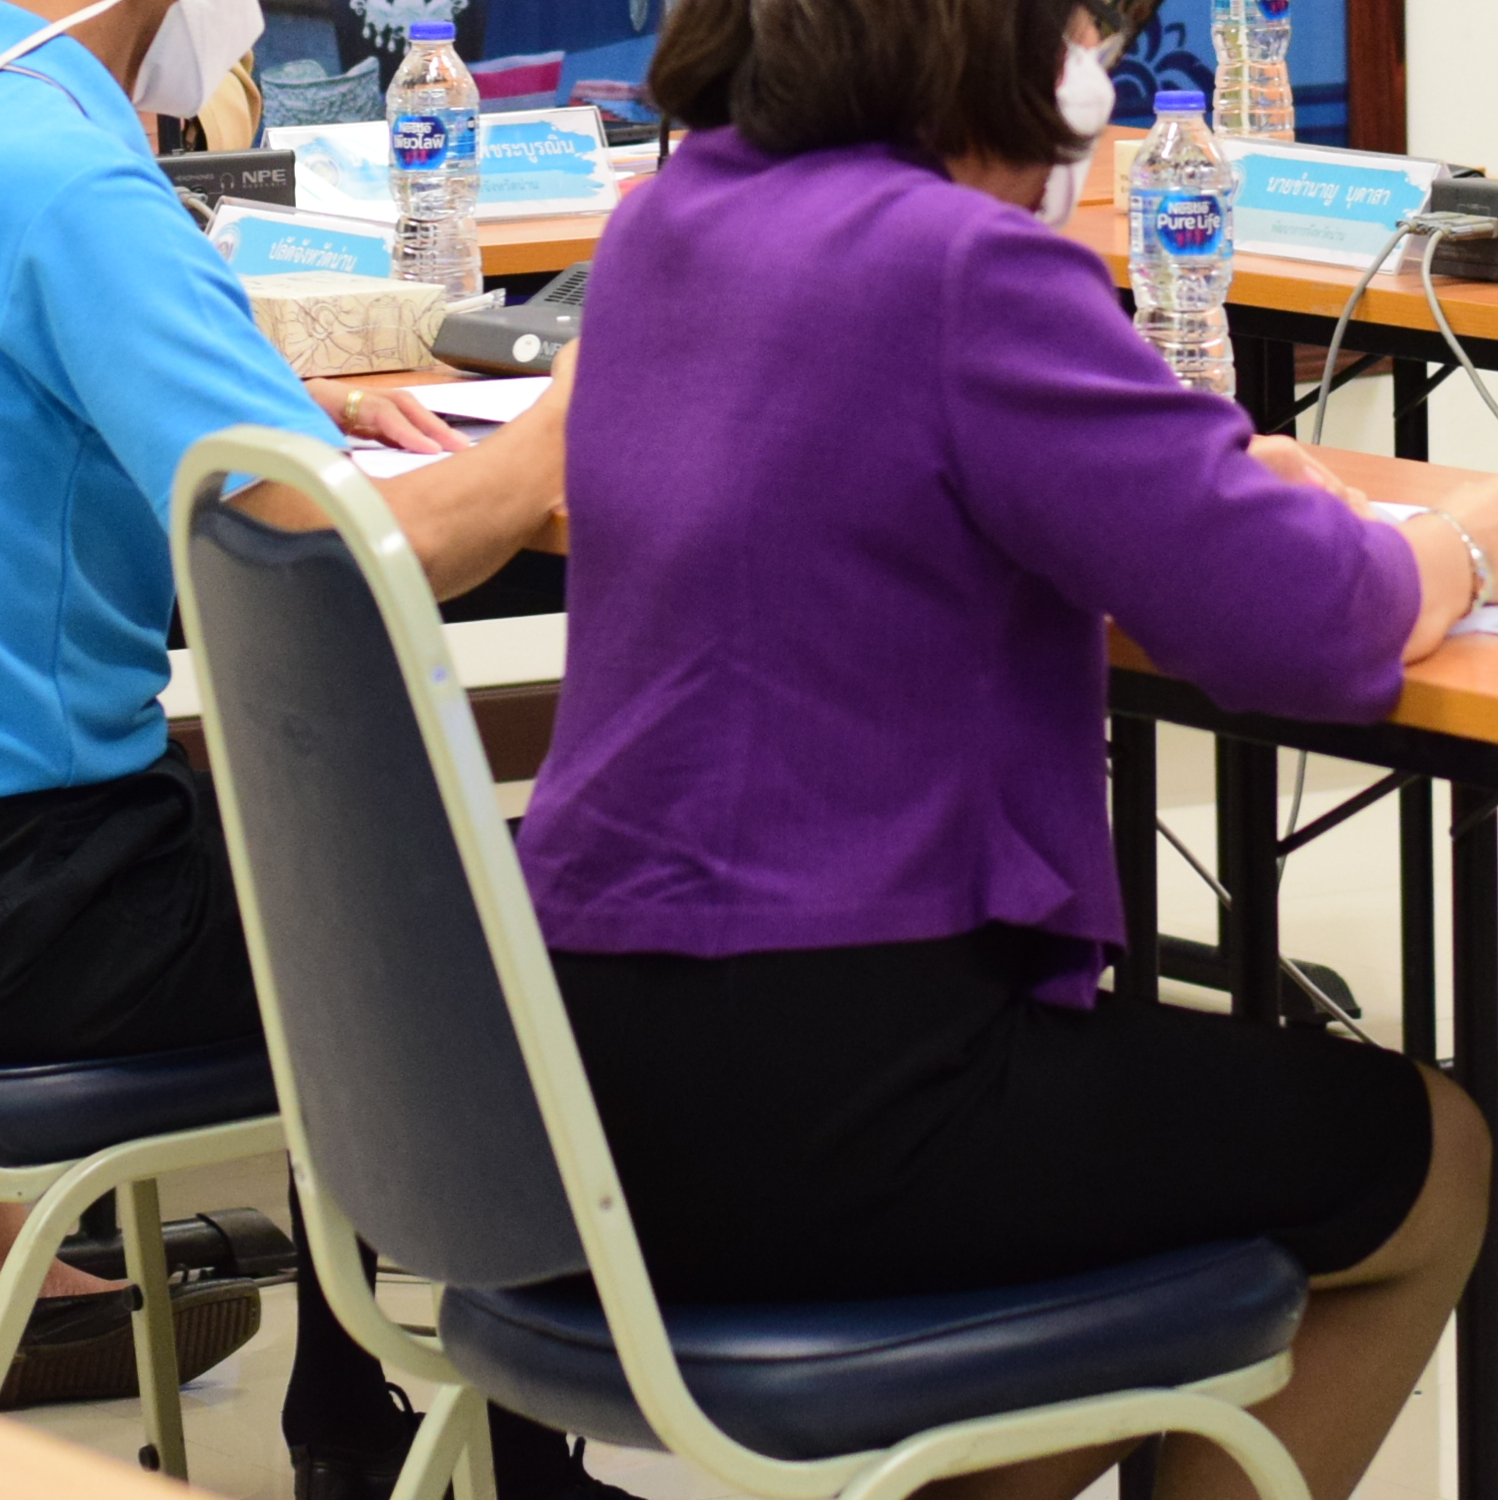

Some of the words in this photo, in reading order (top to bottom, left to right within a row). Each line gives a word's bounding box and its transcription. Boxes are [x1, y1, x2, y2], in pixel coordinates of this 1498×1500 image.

[479, 133, 576, 164] พชระบูรณิน
[242, 168, 286, 184] NPE
[1157, 213, 1195, 230] Pure
[1196, 213, 1221, 235] Life
[541, 340, 562, 355] NP
